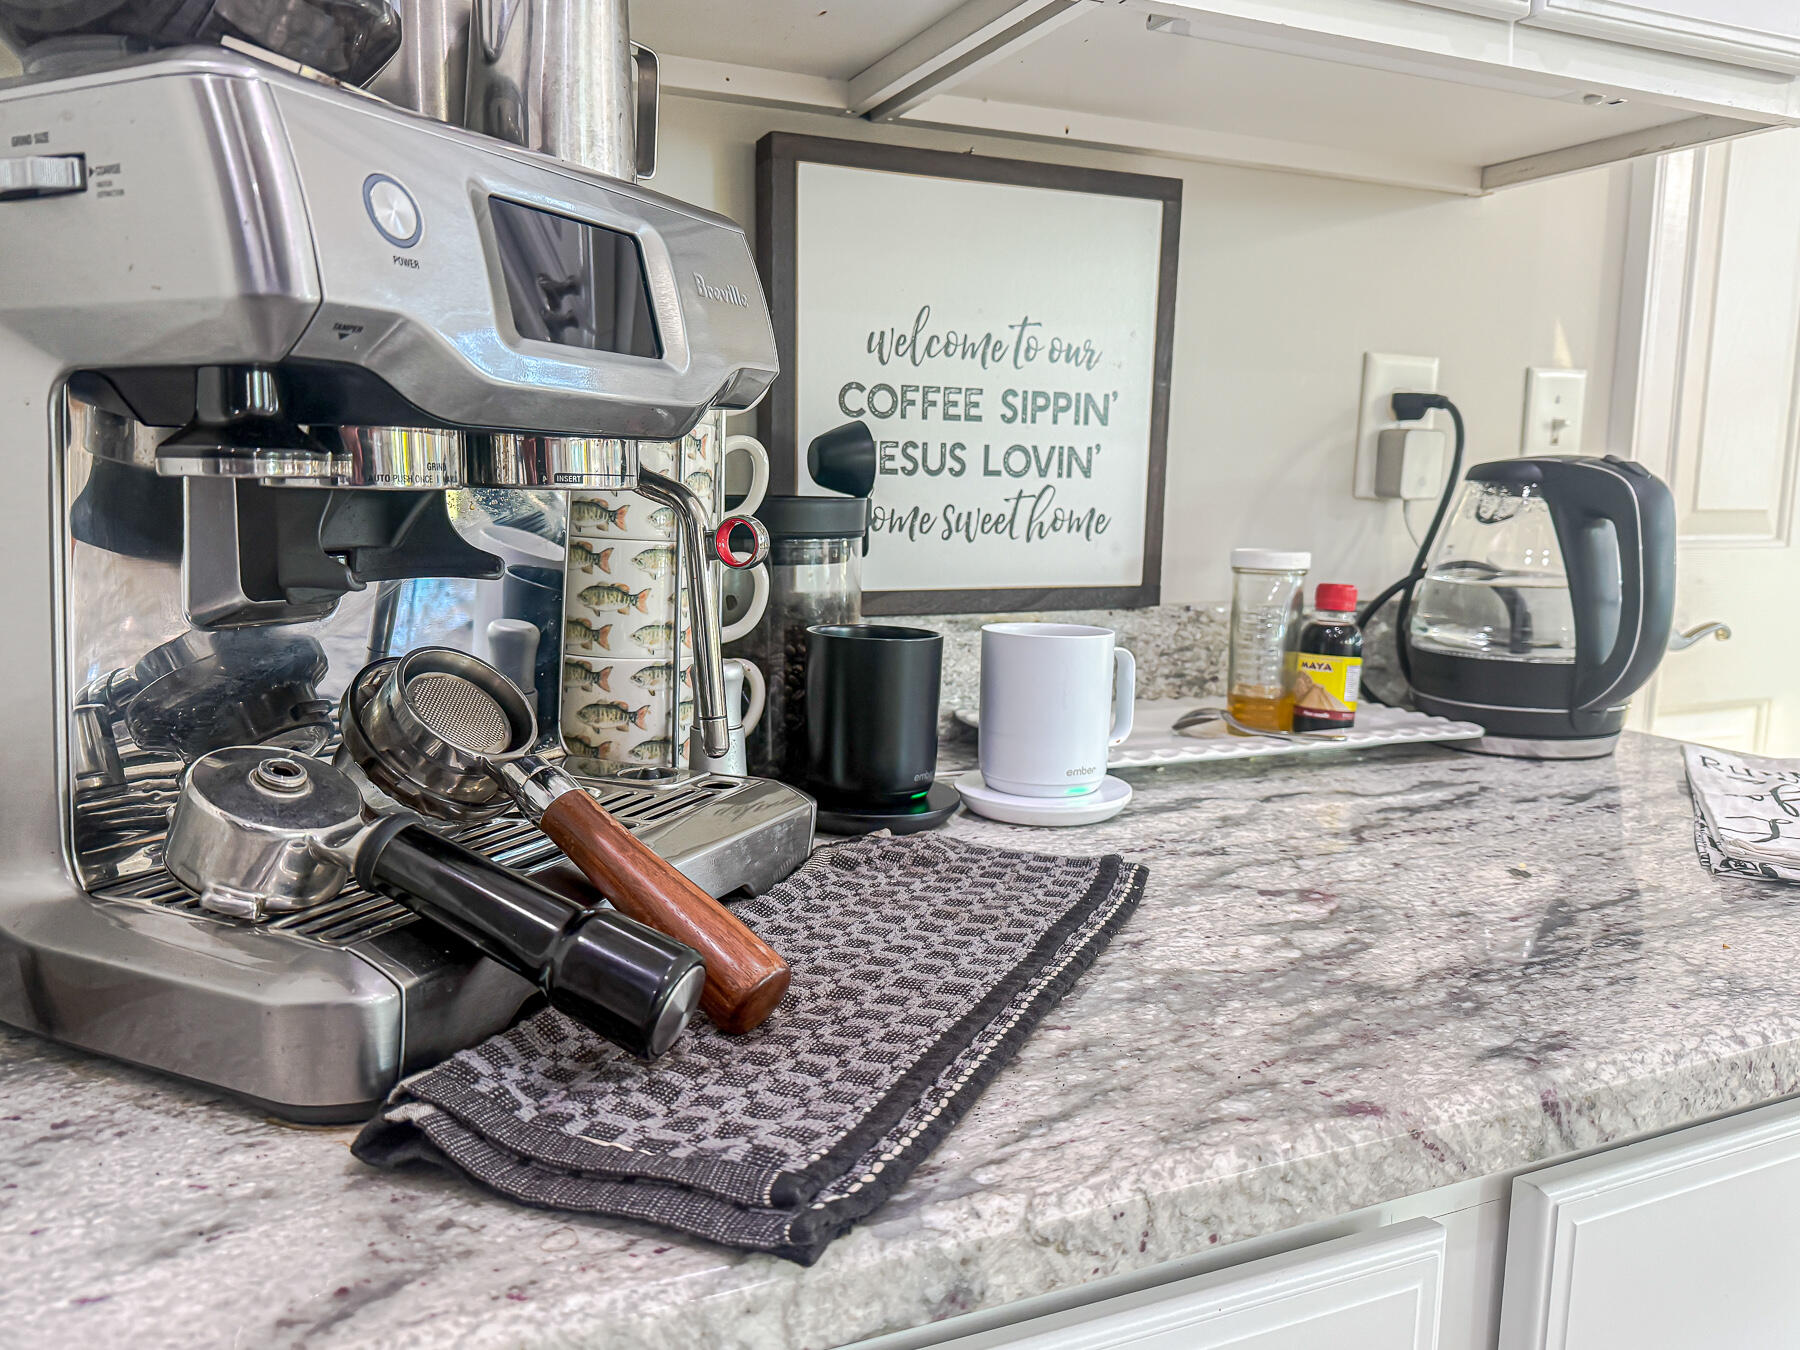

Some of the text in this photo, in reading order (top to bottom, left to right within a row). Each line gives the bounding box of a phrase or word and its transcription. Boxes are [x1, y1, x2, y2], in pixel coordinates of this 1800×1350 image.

[393, 255, 420, 270] POWER
[693, 271, 749, 308] Breville
[332, 322, 364, 334] TAMPER
[866, 305, 1103, 371] welcome to our
[838, 381, 1119, 427] COFFEE SIPPIN'
[873, 440, 1102, 479] ESUS LOVIN'
[368, 474, 390, 483] AUTO
[392, 474, 413, 483] PUSH
[556, 475, 582, 484] INSERT
[870, 484, 1111, 543] ome sweet home
[1302, 661, 1332, 671] MAYA
[1066, 765, 1096, 777] ember
